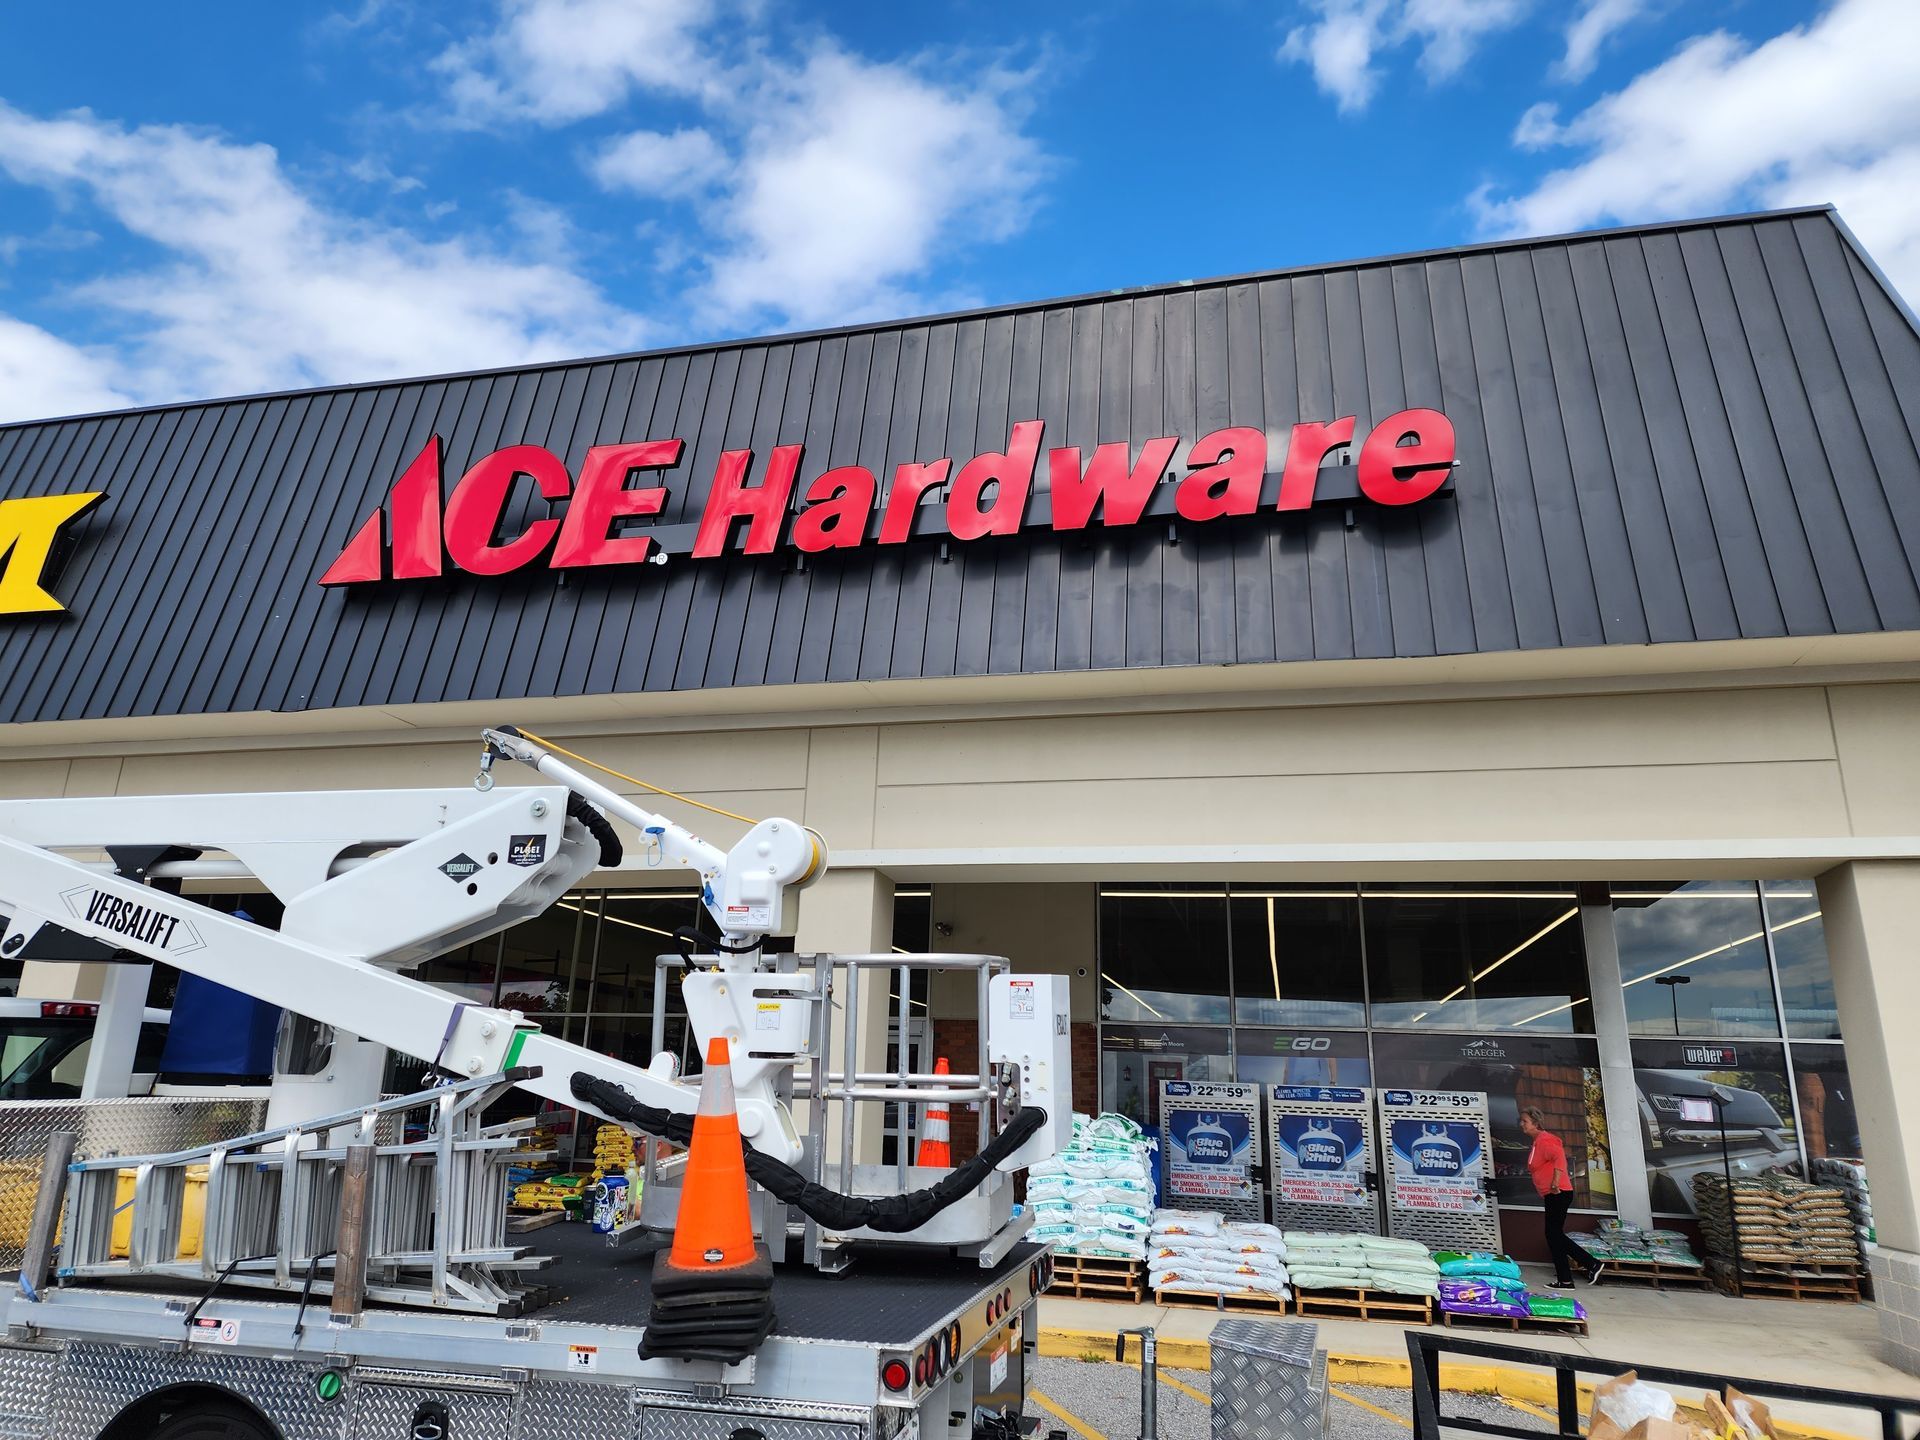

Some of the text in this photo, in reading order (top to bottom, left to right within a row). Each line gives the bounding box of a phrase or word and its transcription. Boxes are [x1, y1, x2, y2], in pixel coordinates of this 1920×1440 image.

[319, 407, 1458, 588] ACE Hardware
[446, 863, 475, 873] VERSALIFT
[85, 890, 180, 949] VERSALIFT
[1273, 1037, 1331, 1050] EGO
[1461, 1048, 1506, 1057] TRAEGER
[1687, 1047, 1722, 1063] weber
[1657, 1097, 1681, 1110] webe
[1197, 1138, 1223, 1147] Blue
[1194, 1147, 1229, 1158] Rhino
[1308, 1144, 1336, 1153] Blue
[1423, 1149, 1452, 1159] Blue
[1305, 1153, 1342, 1164] Rhino
[1420, 1158, 1459, 1170] Rhino
